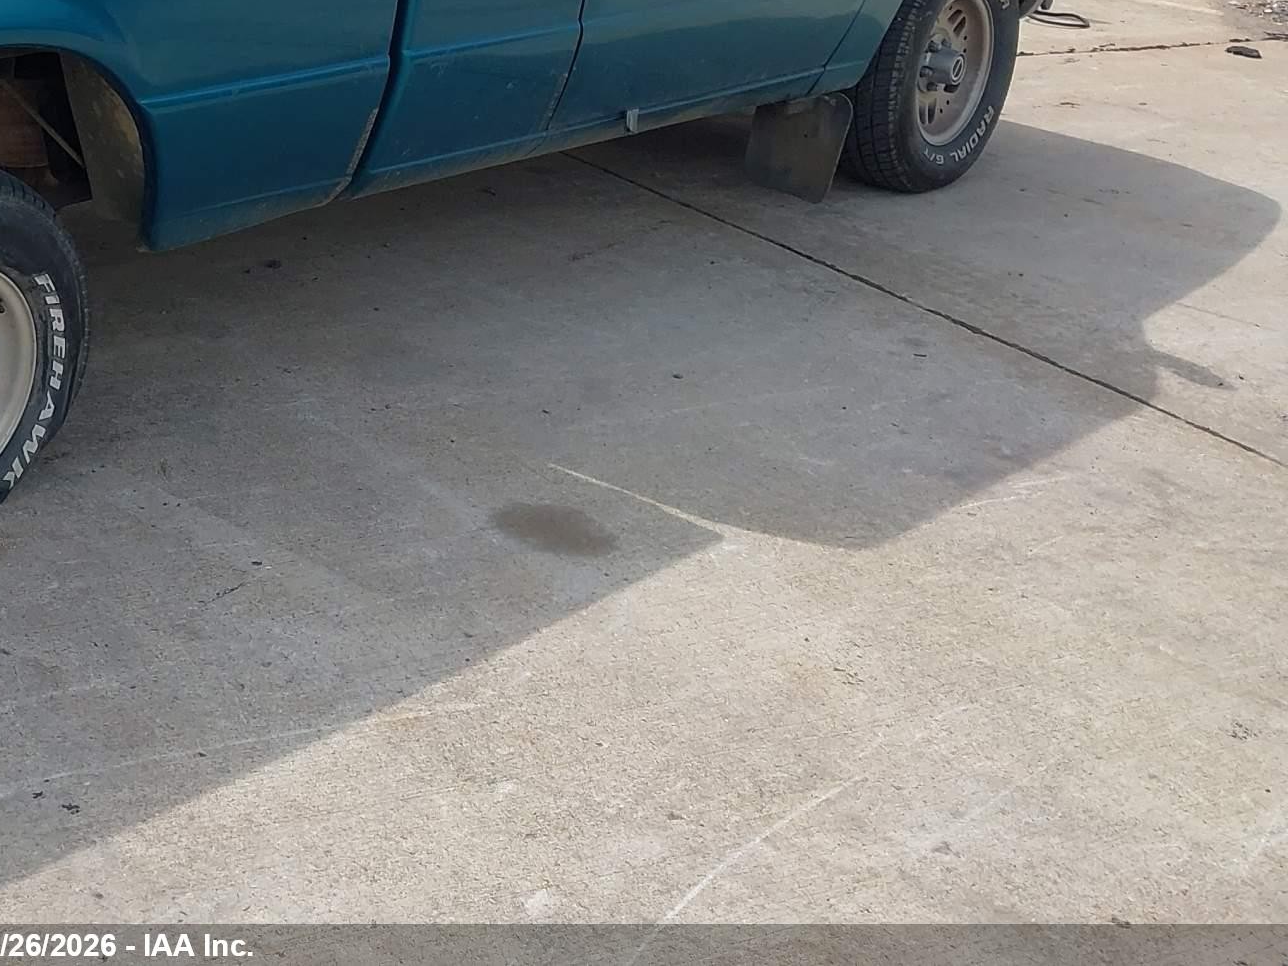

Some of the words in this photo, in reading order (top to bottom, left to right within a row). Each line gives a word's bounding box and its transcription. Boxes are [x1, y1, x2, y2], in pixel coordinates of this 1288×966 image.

[922, 145, 945, 165] G/T
[949, 105, 996, 162] RADIAL
[2, 273, 66, 489] FIREHAWK
